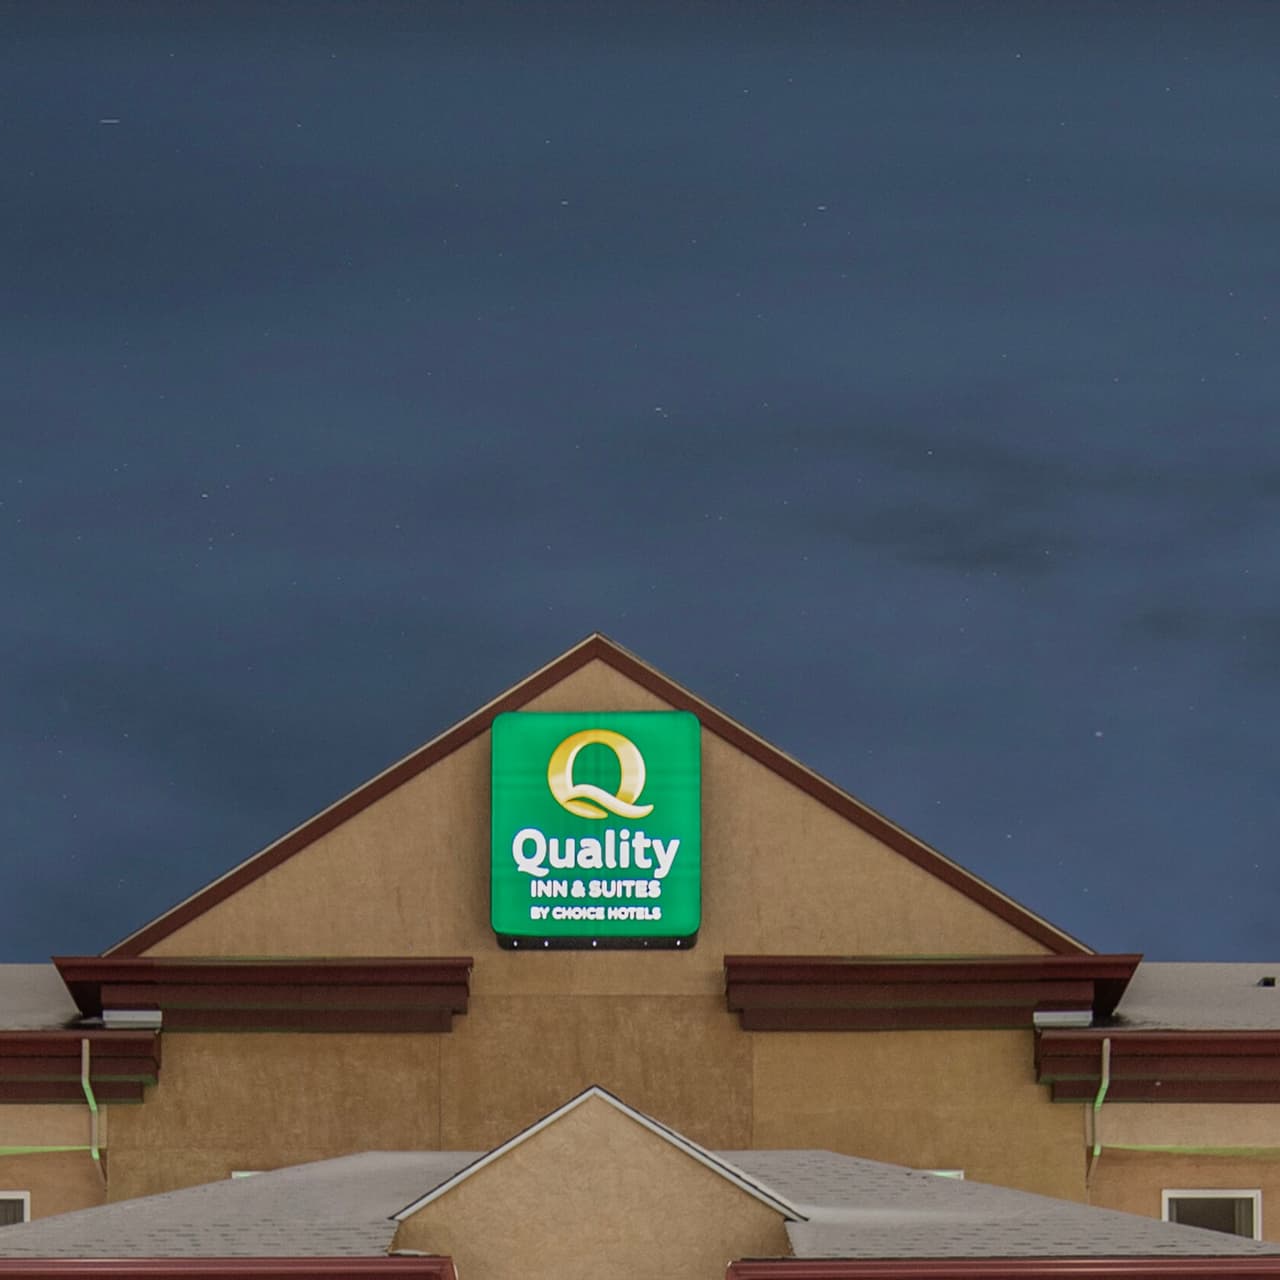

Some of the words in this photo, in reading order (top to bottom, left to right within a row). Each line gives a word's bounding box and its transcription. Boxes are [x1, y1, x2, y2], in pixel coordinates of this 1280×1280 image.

[547, 729, 654, 819] Q
[512, 828, 680, 879] Quality
[531, 880, 568, 898] INN
[571, 880, 586, 898] &
[589, 880, 661, 898] SUITES
[530, 907, 550, 920] BY
[552, 907, 605, 920] CHOICE
[608, 907, 662, 920] HOTELS
